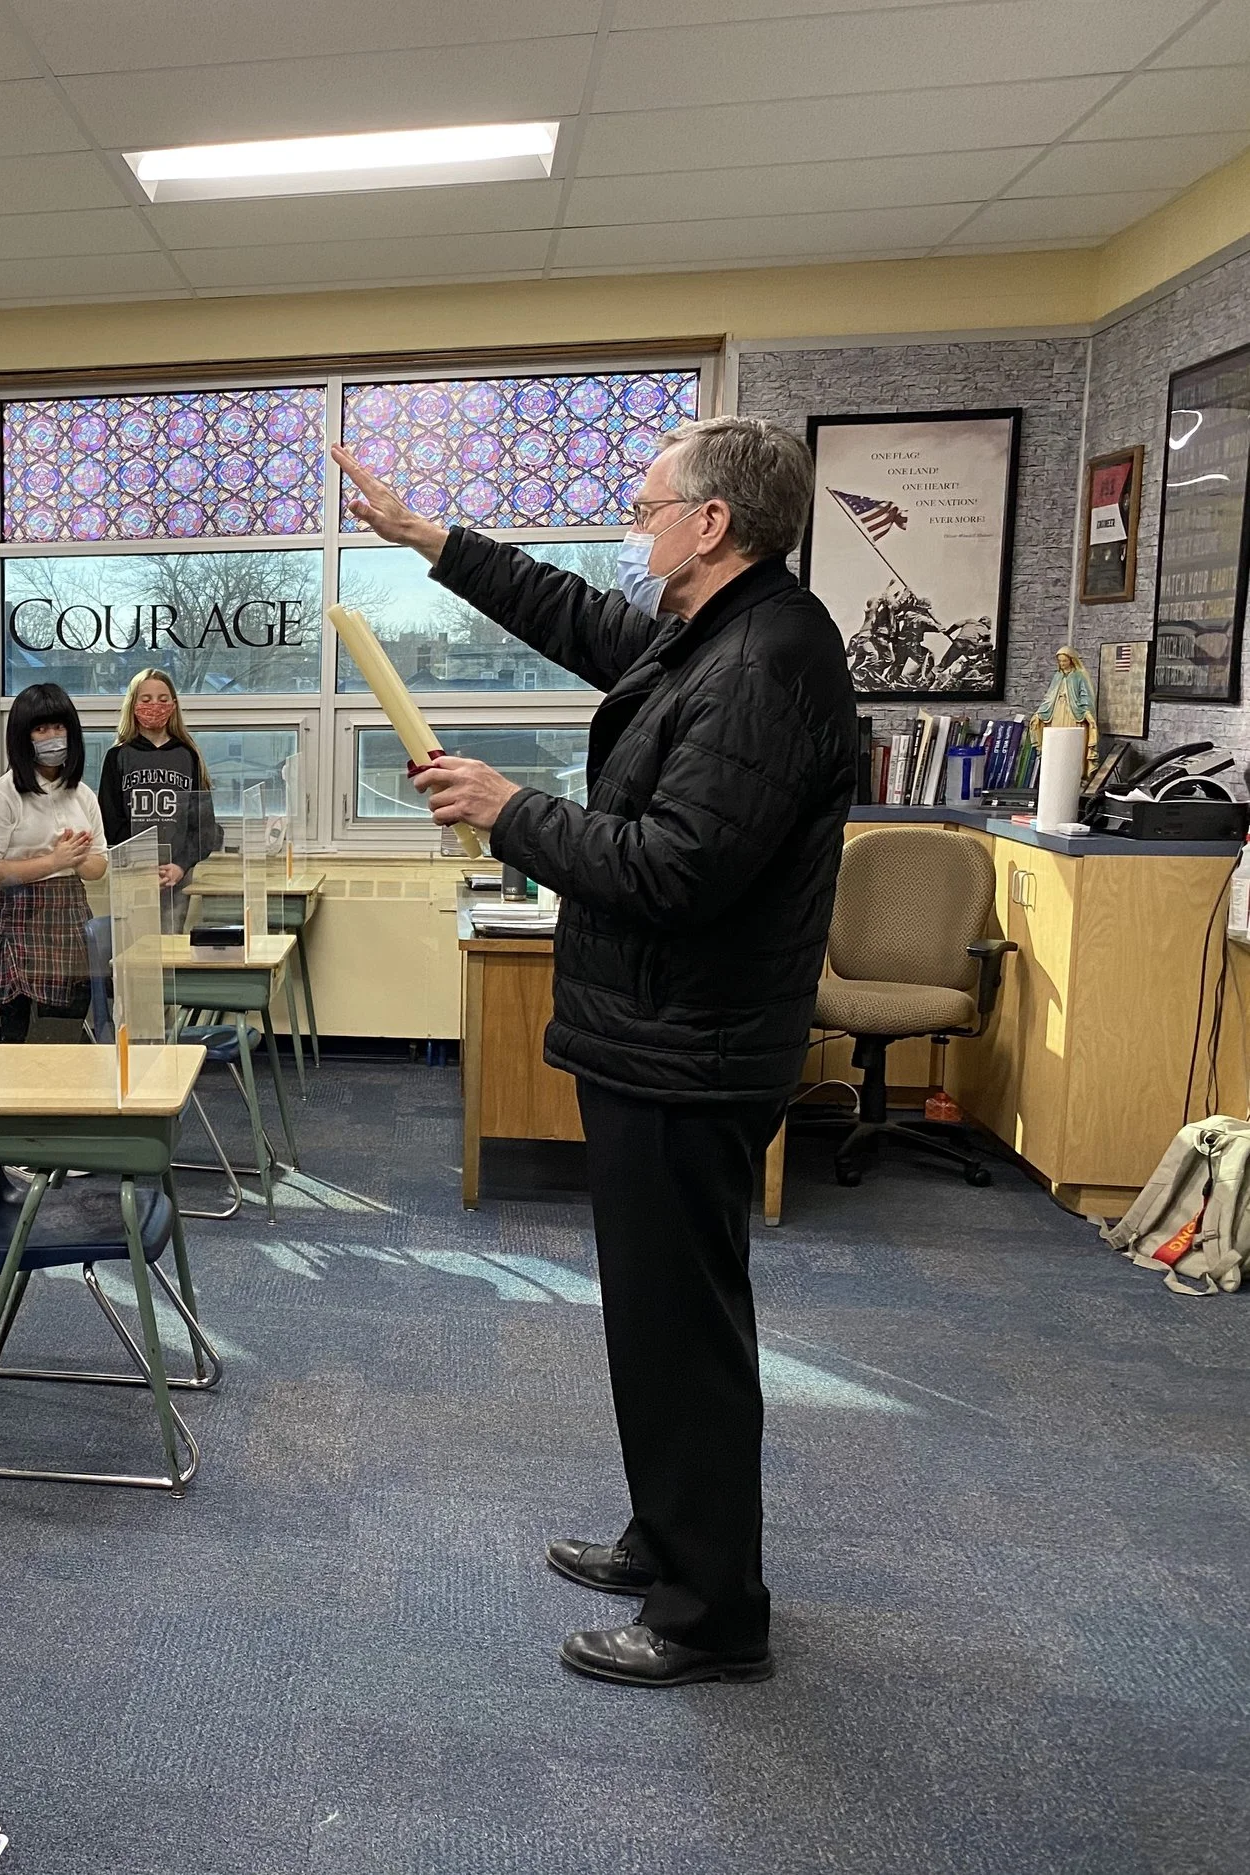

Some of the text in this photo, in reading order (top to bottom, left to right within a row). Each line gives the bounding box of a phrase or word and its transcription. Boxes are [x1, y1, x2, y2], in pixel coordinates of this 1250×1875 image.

[910, 467, 939, 475] LAND!
[902, 482, 959, 491] ONE HEART!
[939, 498, 978, 506] NATION!
[954, 516, 985, 524] MORE!
[9, 598, 303, 651] COURAGE
[122, 769, 193, 791] ASHINGTO
[131, 788, 177, 817] DC
